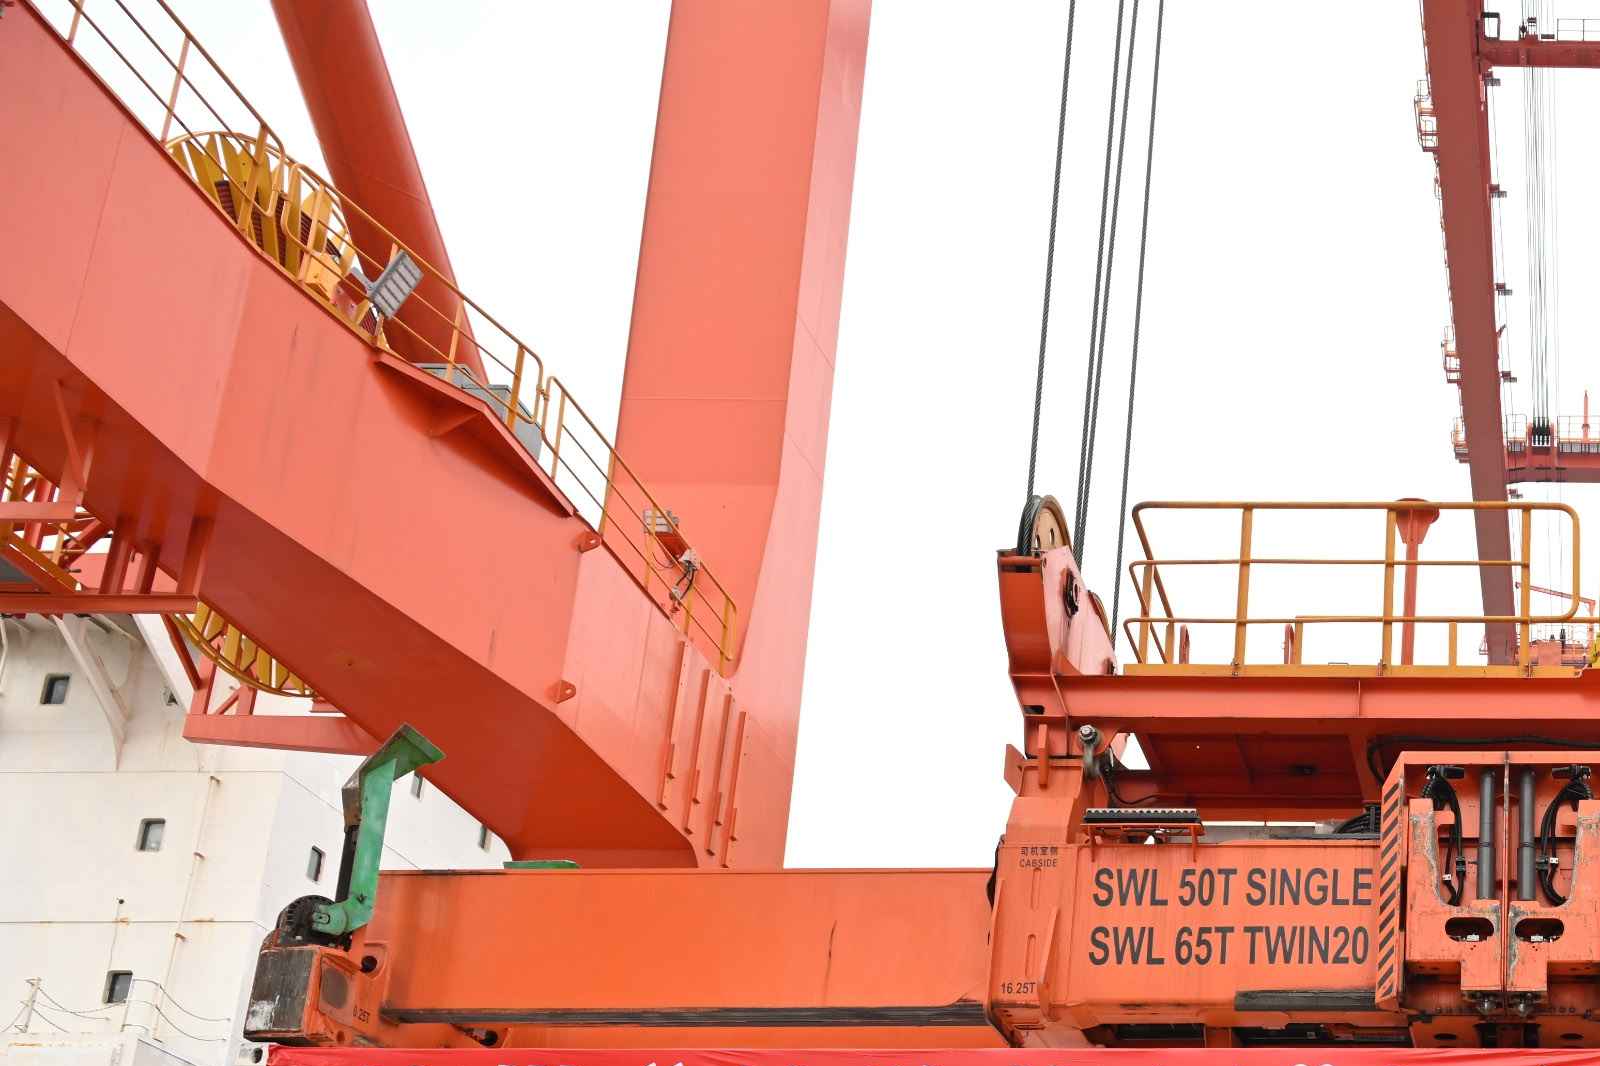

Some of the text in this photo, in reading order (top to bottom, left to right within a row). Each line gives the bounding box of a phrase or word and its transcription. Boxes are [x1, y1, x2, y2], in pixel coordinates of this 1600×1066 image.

[1020, 859, 1058, 868] CABSIDE
[1093, 867, 1374, 907] SWL 50T SINGLE
[1089, 925, 1369, 965] SWL 65T TWIN20
[1001, 982, 1036, 994] 16.25T
